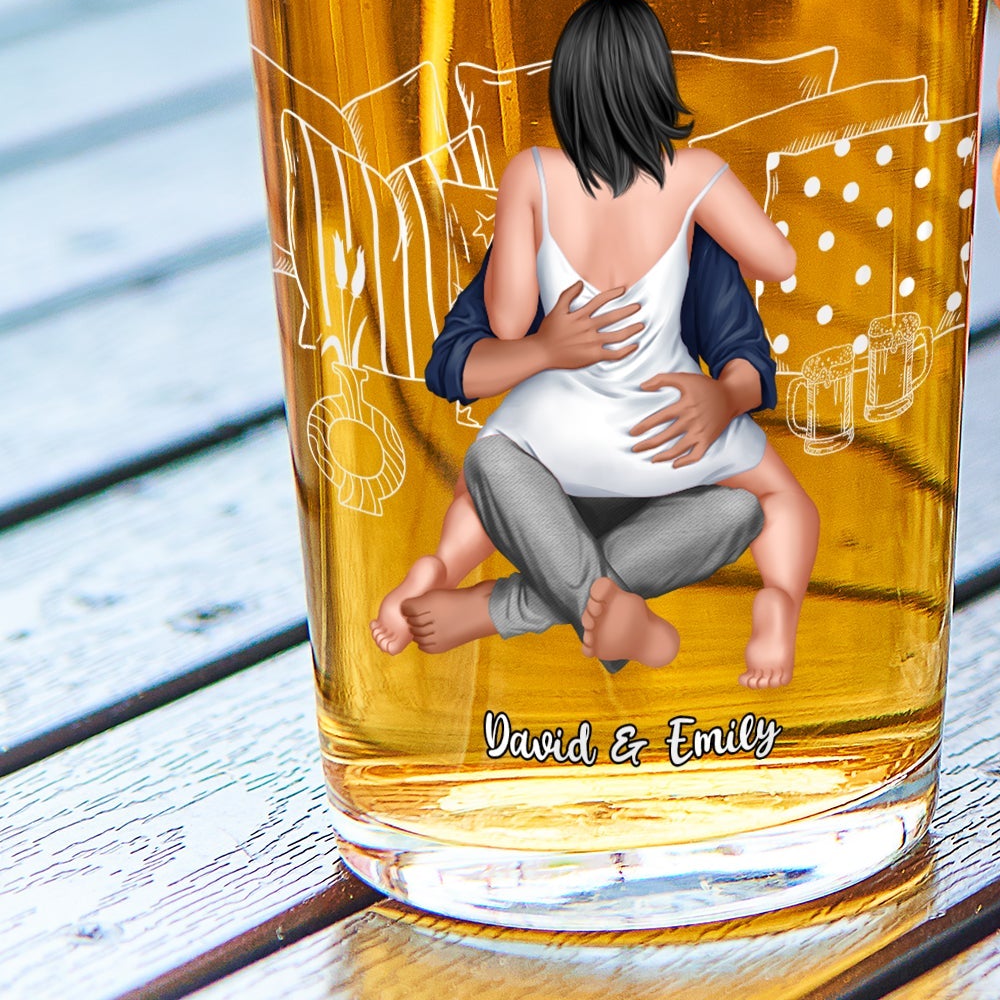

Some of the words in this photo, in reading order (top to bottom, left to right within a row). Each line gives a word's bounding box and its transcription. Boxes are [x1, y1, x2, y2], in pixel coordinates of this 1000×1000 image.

[484, 710, 598, 766] David
[610, 724, 648, 766] &
[666, 713, 782, 766] Emily
